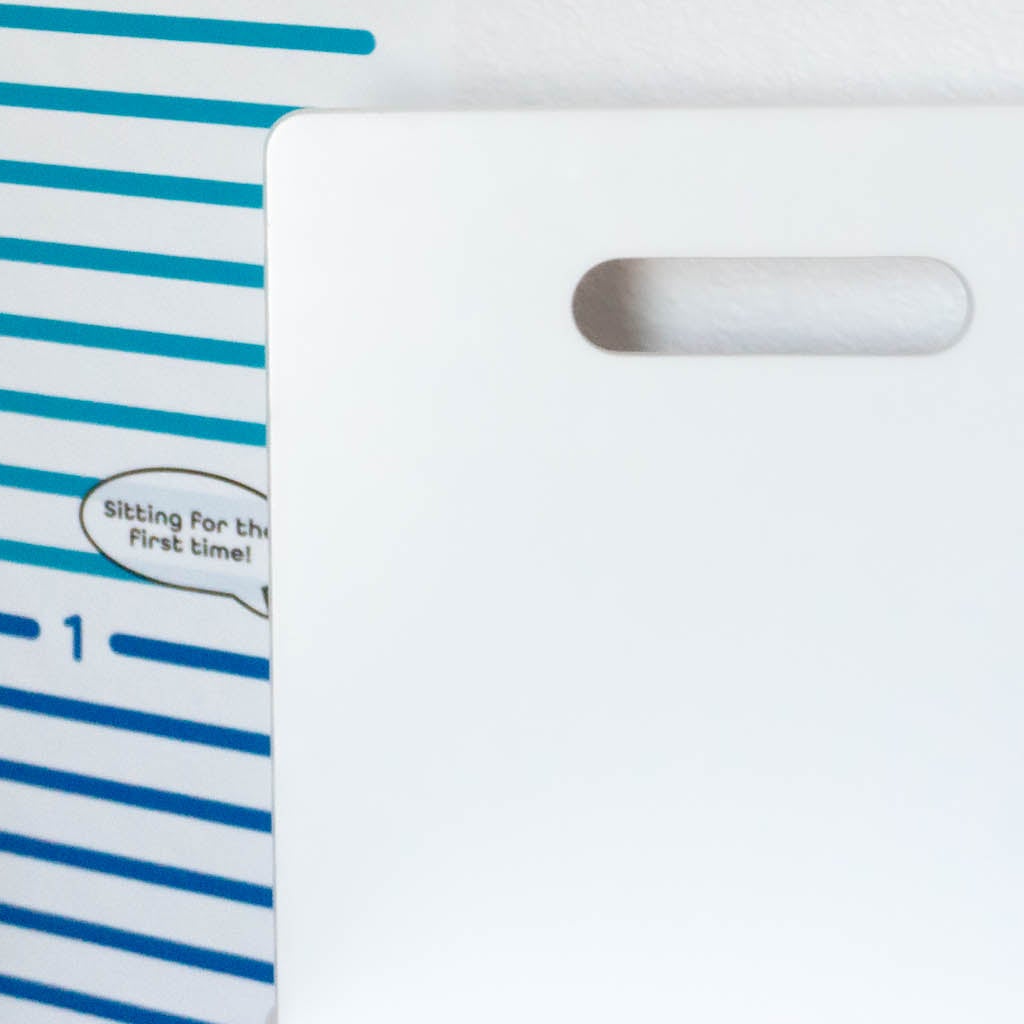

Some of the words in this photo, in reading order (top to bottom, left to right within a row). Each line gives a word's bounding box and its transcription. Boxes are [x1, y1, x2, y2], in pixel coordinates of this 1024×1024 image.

[104, 500, 182, 532] Sitting
[191, 511, 229, 533] for
[130, 528, 184, 553] first
[191, 539, 252, 563] time!
[64, 614, 83, 662] 1
